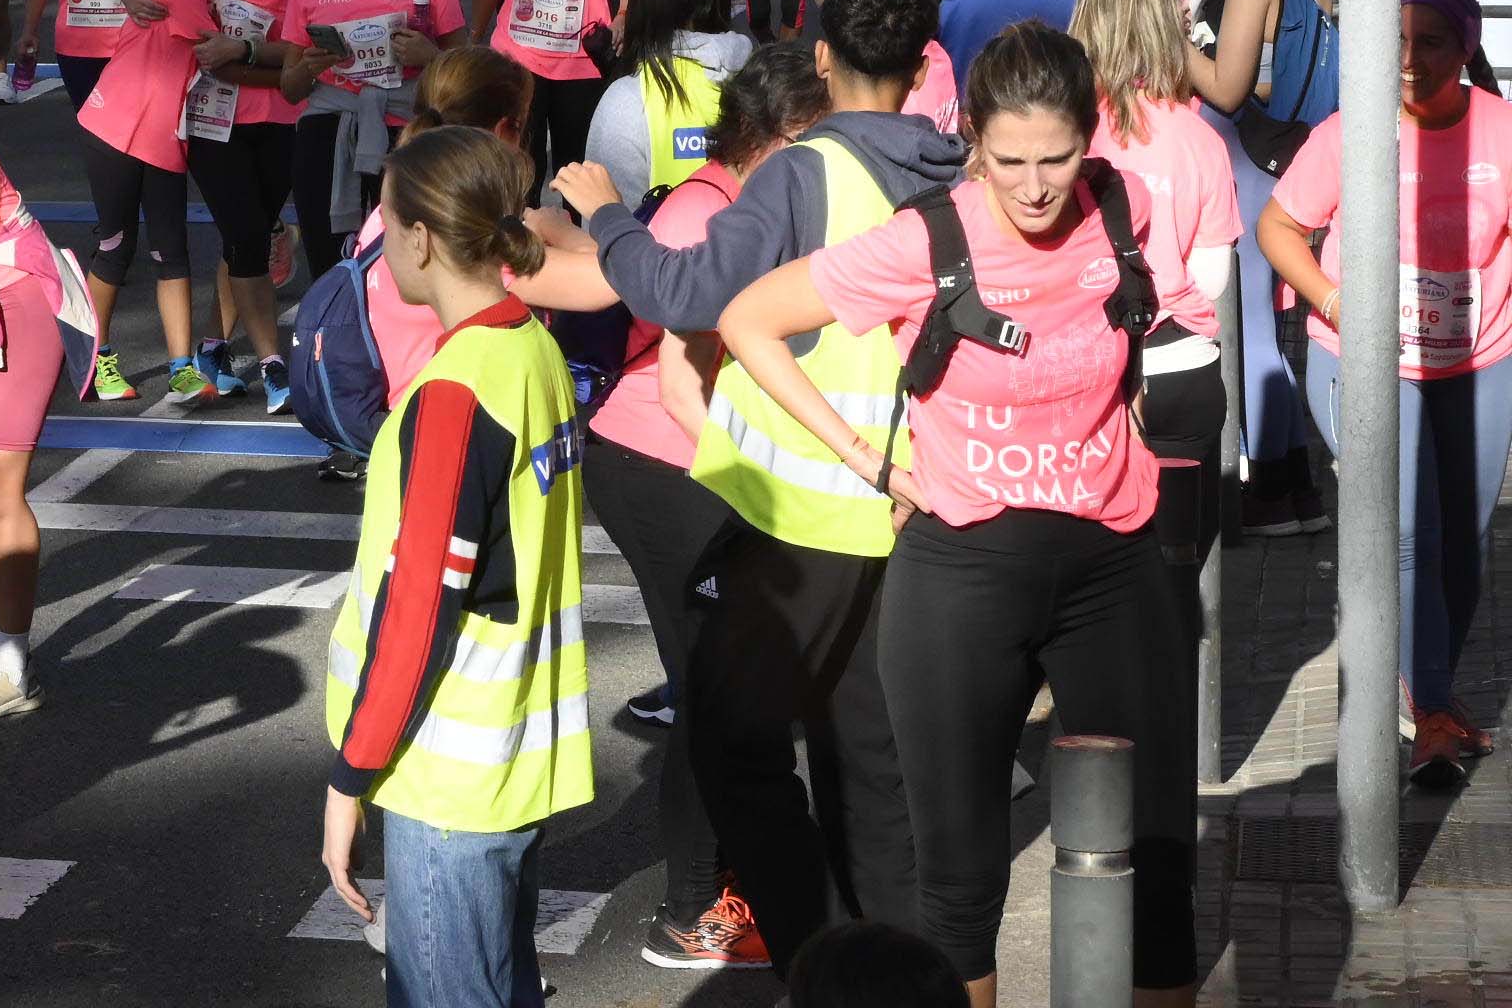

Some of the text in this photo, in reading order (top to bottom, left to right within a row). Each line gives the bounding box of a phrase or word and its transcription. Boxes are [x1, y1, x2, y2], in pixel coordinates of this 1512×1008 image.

[535, 9, 558, 23] 016
[357, 46, 386, 60] 016
[938, 276, 955, 288] XC
[983, 288, 1031, 306] SHO
[1401, 305, 1441, 324] 016
[960, 401, 1012, 430] TU
[976, 477, 1099, 506] SUMA
[695, 586, 719, 600] adidas
